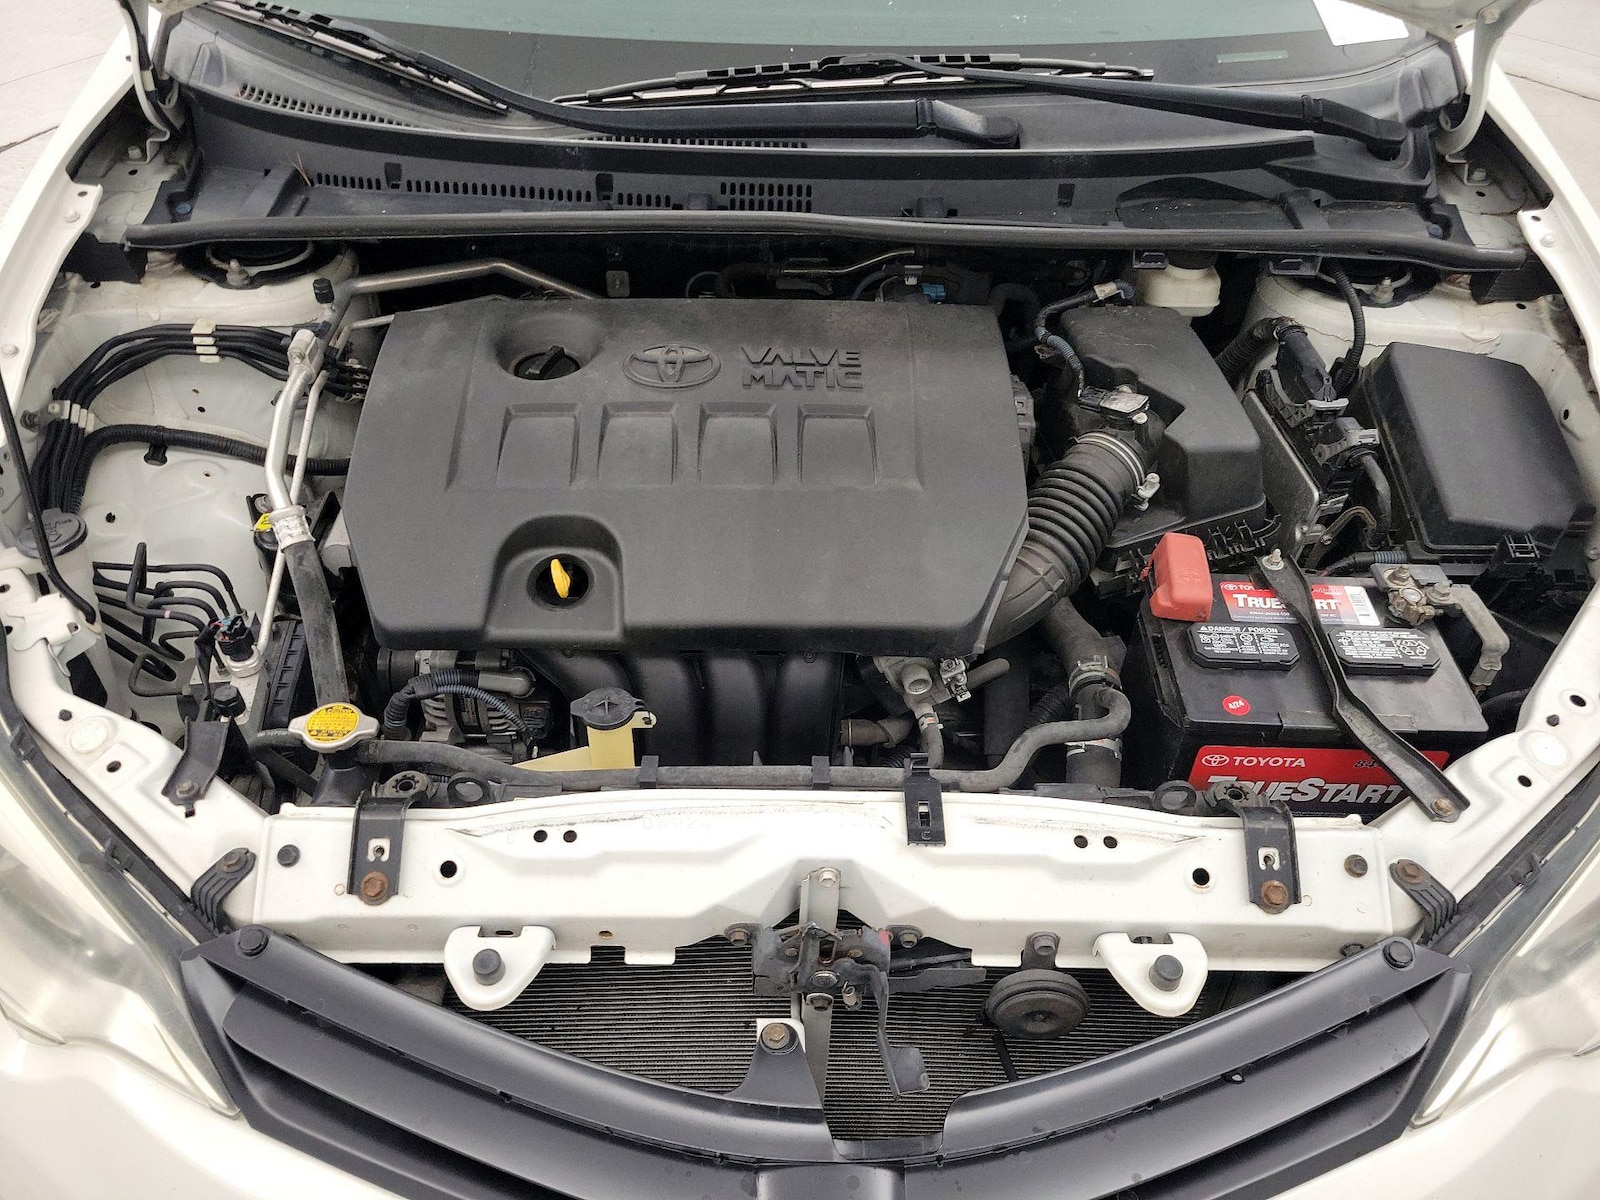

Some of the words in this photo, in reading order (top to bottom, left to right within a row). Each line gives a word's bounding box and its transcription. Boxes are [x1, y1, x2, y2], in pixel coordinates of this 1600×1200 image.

[741, 347, 862, 367] VALVE
[742, 368, 863, 388] MATIC
[1233, 756, 1306, 768] TOYOTA
